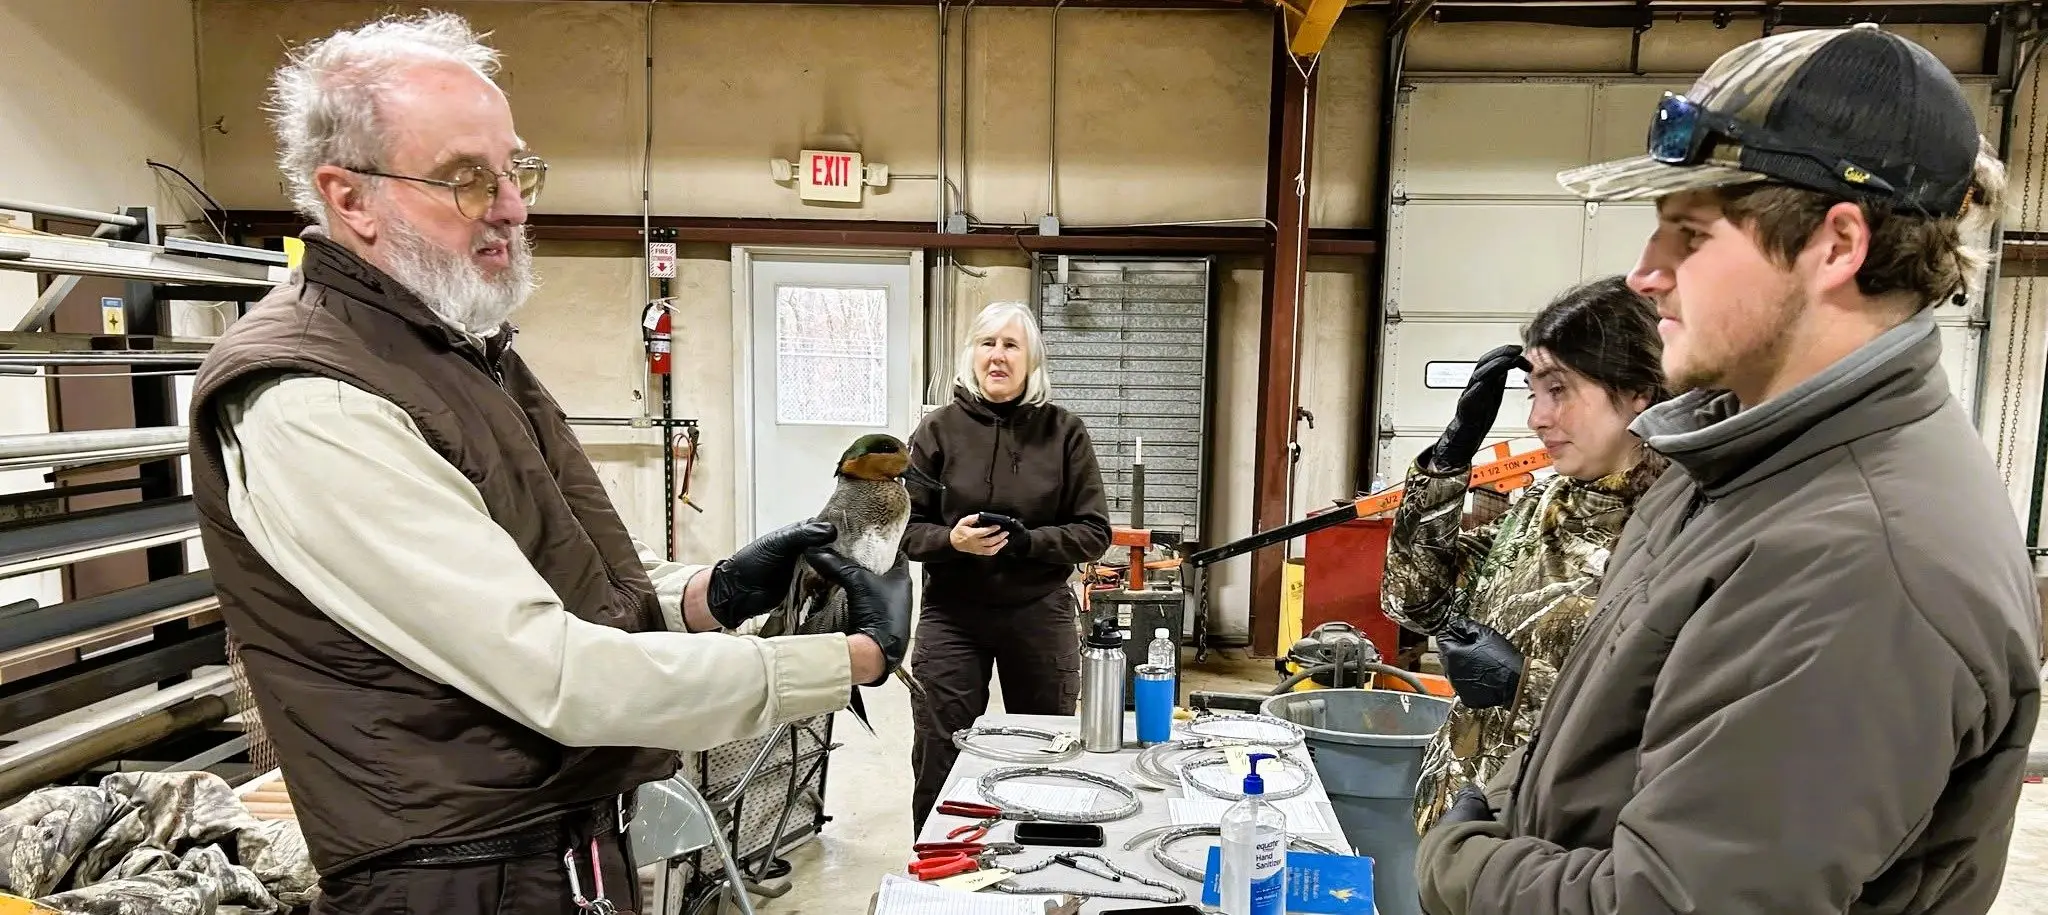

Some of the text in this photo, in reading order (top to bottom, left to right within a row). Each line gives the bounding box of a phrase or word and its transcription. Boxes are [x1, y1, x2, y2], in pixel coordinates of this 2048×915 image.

[812, 155, 851, 187] EXIT
[1480, 470, 1485, 478] 1
[1488, 466, 1500, 476] 1/2
[1504, 460, 1520, 471] TON
[1530, 456, 1536, 464] 2
[1385, 494, 1398, 503] 1/2
[1256, 840, 1279, 851] equate
[1256, 852, 1273, 862] Hand
[1256, 859, 1282, 870] Sanitizer
